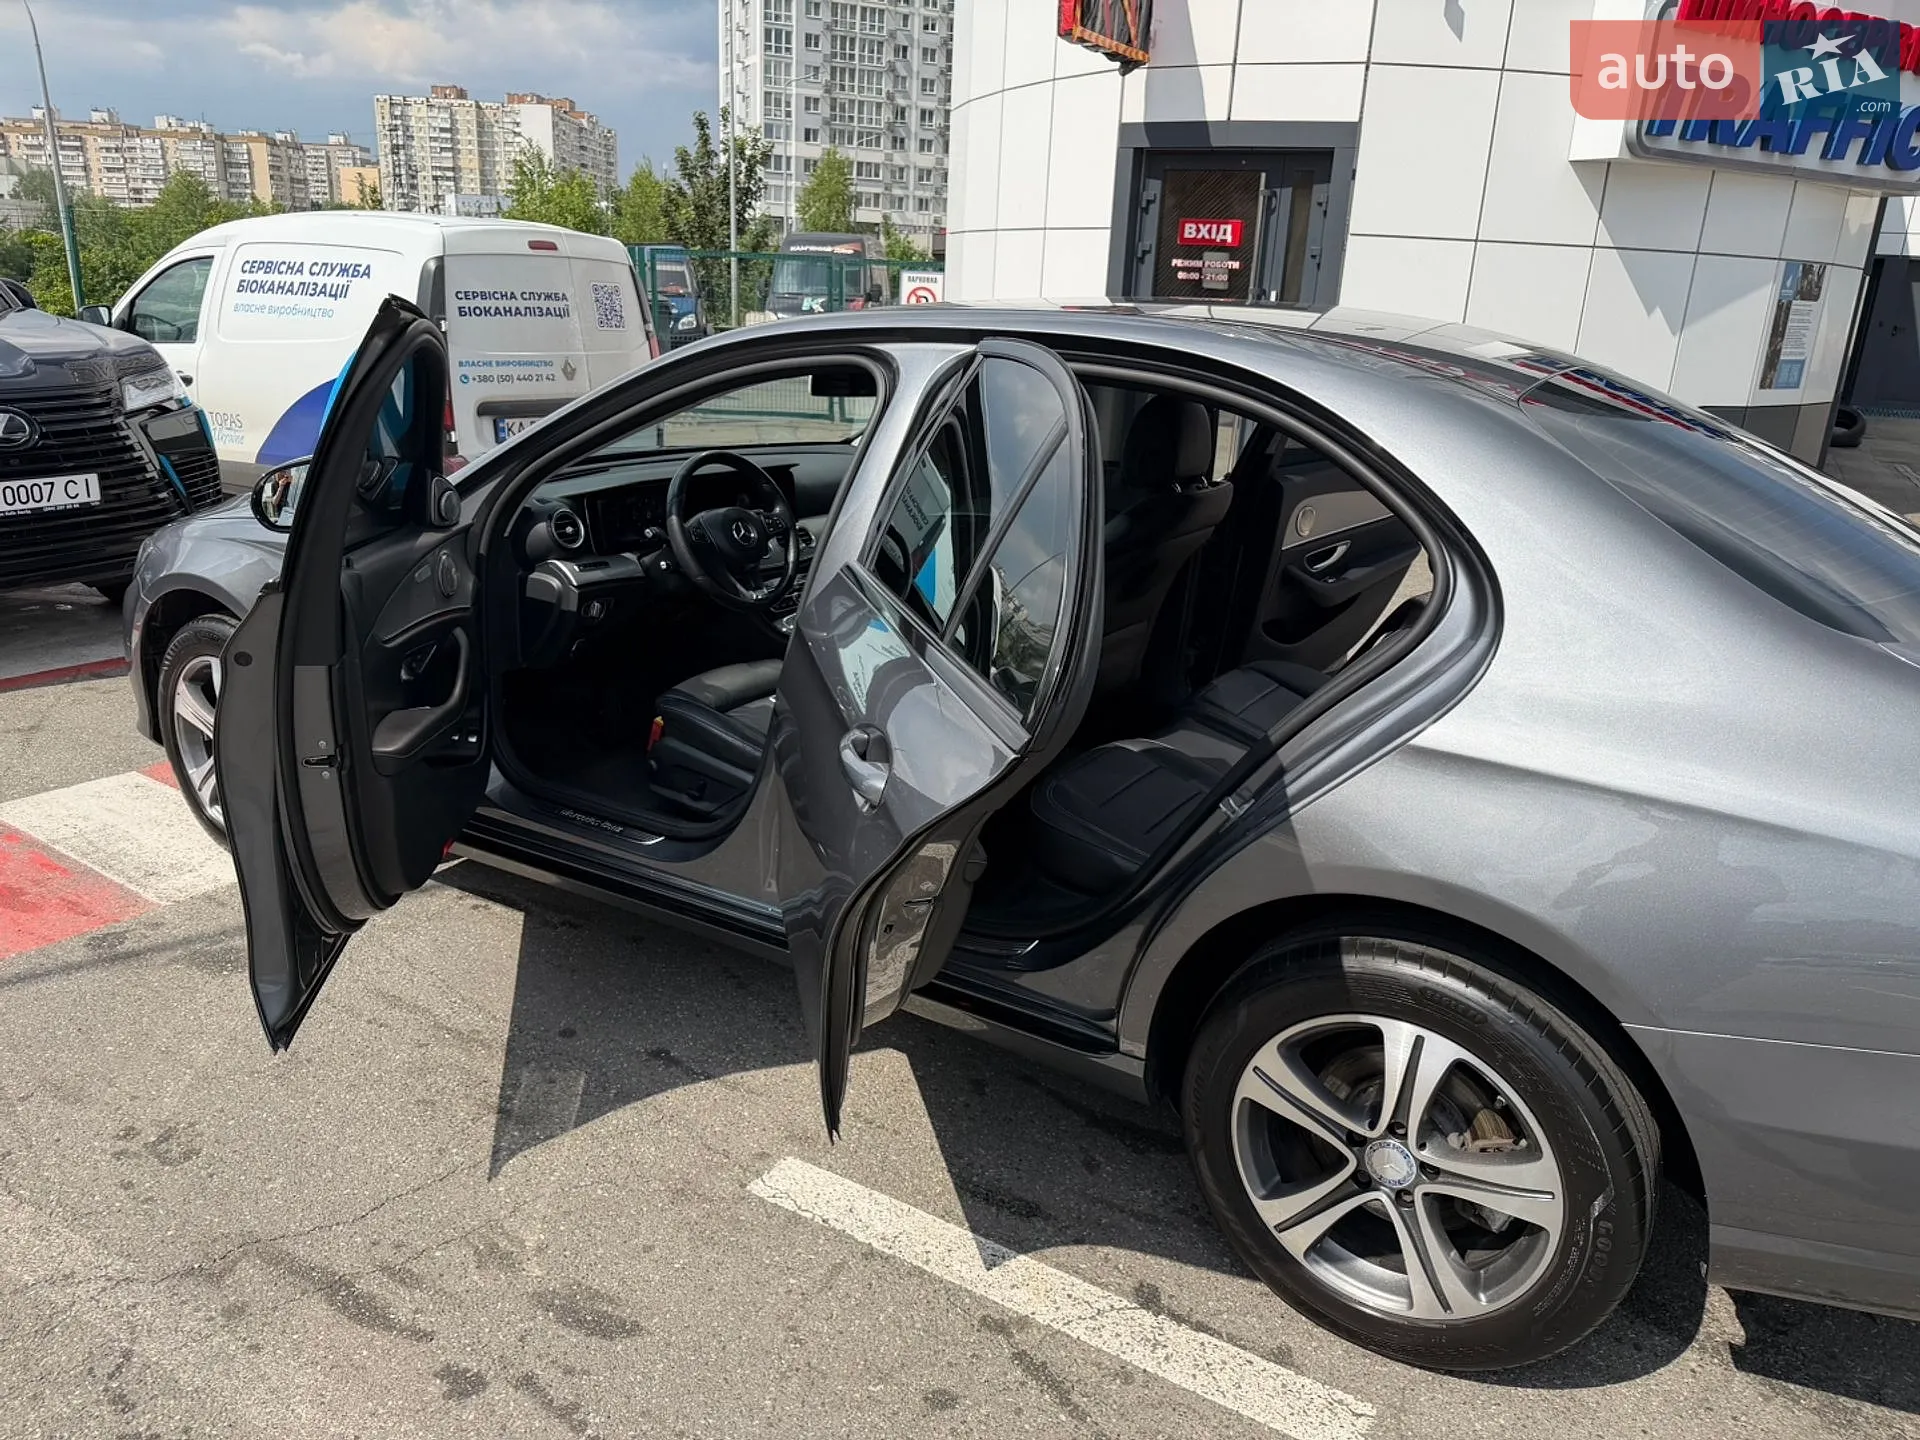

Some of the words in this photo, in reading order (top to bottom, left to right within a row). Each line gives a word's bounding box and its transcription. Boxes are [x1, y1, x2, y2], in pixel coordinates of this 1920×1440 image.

[1647, 60, 1920, 172] TRAFFIC
[1183, 222, 1233, 243] ВХІД
[241, 260, 304, 276] СЕРВІСНА
[309, 262, 371, 279] СЛУЖБА
[1171, 259, 1203, 268] РЕЖИМ
[1204, 260, 1240, 270] РОБОТИ
[1205, 273, 1228, 281] 21:00
[236, 279, 352, 301] БІОКАНАЛІЗАЦІЇ
[455, 290, 518, 301] СЕРВІСНА
[520, 291, 569, 302] СЛУЖБА
[234, 302, 266, 314] власне
[268, 303, 334, 319] виробництво
[458, 304, 570, 319] БІОКАНАЛІЗАЦІЇ
[459, 360, 492, 368] ВЛАСНЕ
[495, 360, 553, 369] ВИРОБНИЦТВО
[472, 374, 495, 383] +380
[496, 374, 514, 384] (50)
[516, 373, 534, 382] 440
[535, 373, 544, 382] 21
[545, 373, 556, 382] 42
[208, 411, 243, 428] TOPAS
[507, 420, 538, 436] KA
[3, 481, 55, 506] 0007
[64, 478, 91, 500] CI
